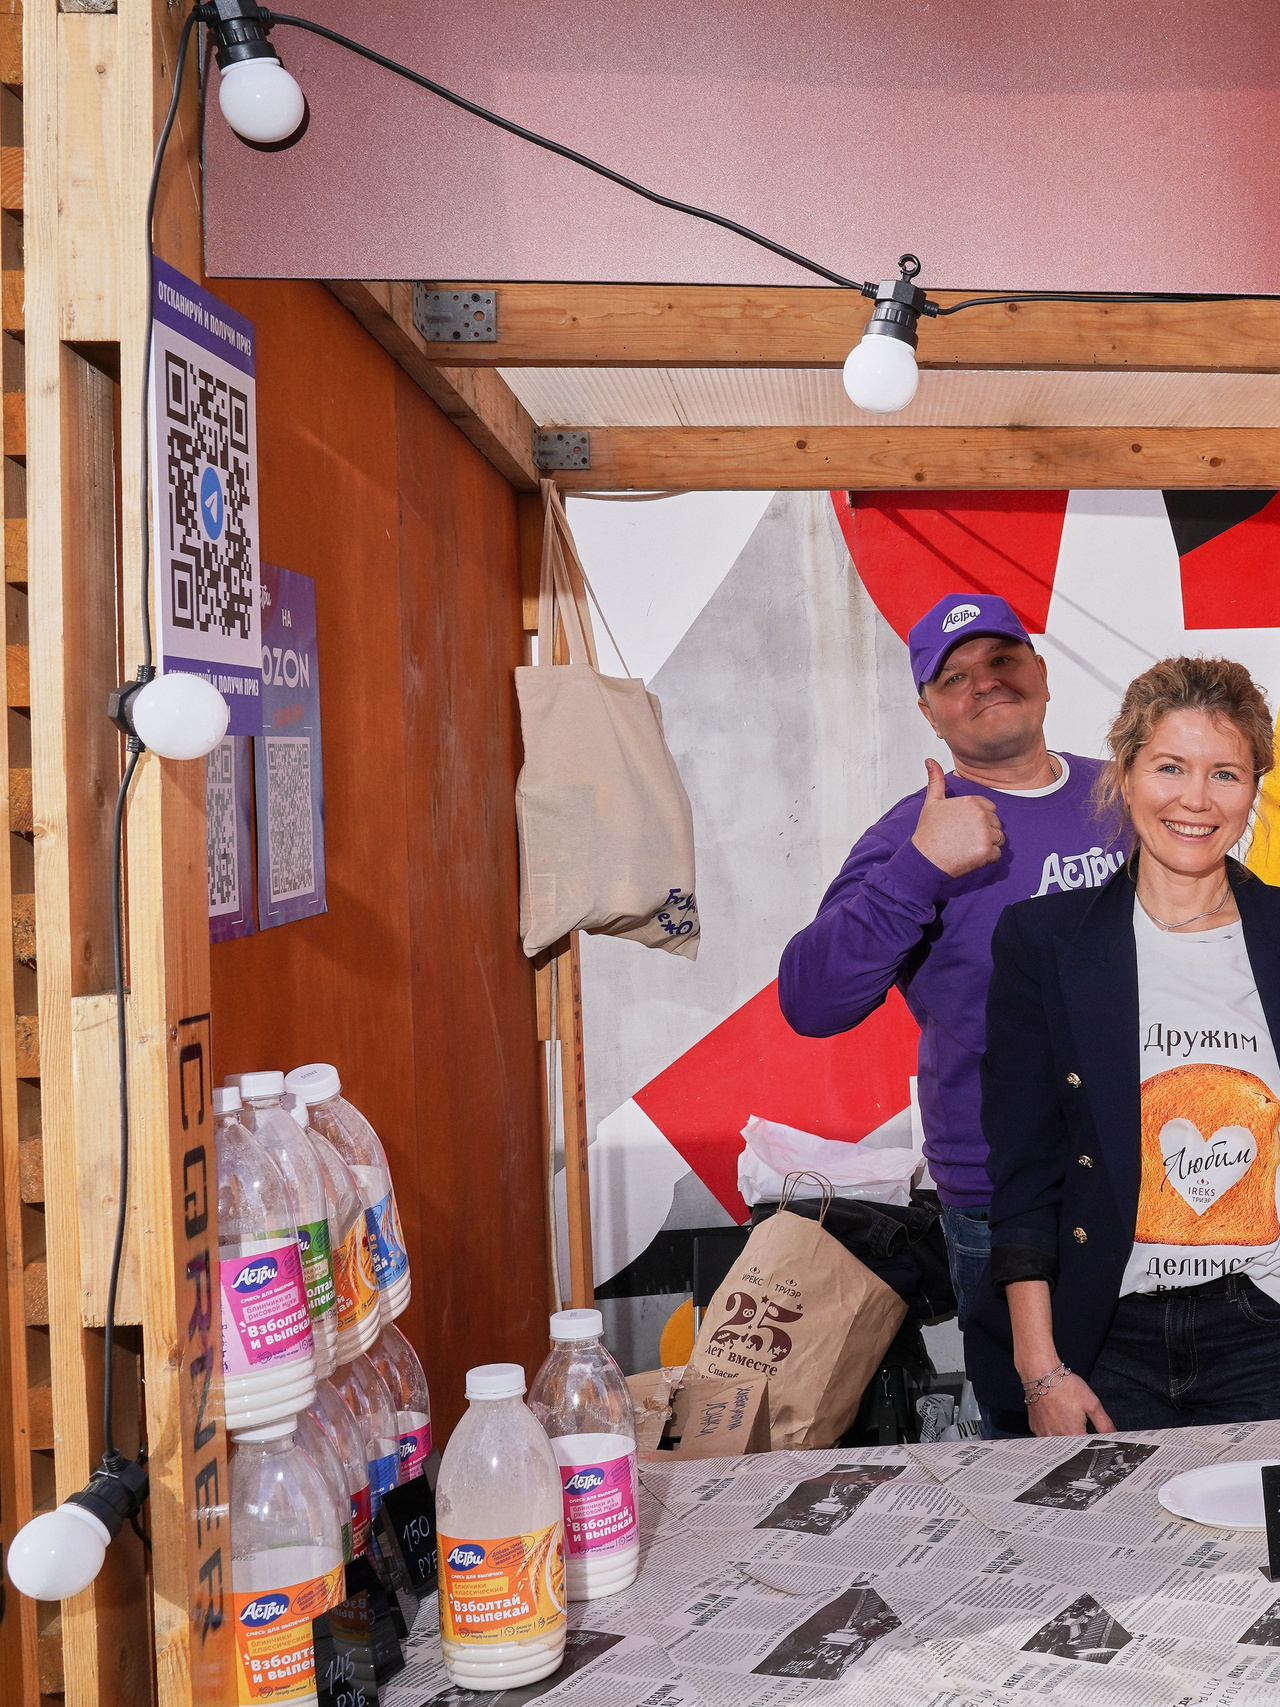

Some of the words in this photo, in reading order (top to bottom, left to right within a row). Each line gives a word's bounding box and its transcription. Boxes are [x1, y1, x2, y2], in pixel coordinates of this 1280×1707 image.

[158, 280, 203, 325] ОТСКАНИРУЙ
[204, 311, 209, 330] И
[209, 314, 236, 346] ПОЛУЧИ
[236, 331, 252, 357] ПРИЗ
[281, 609, 292, 628] НА
[943, 610, 978, 631] Астри
[261, 644, 311, 689] OZON
[219, 675, 244, 695] ПОЛУЧИ
[244, 679, 259, 697] ПРИЗ
[1030, 847, 1125, 898] Астри
[1144, 1023, 1258, 1058] Дружим
[1160, 1140, 1252, 1193] Любим
[1188, 1186, 1216, 1197] IREKS
[231, 1265, 278, 1289] Астри
[742, 1273, 764, 1286] ИРЕКС
[240, 1295, 260, 1304] смесь
[261, 1289, 273, 1299] для
[274, 1281, 294, 1293] выпечки
[774, 1284, 802, 1298] ТРИЭР
[246, 1297, 284, 1313] блинчики
[285, 1293, 292, 1301] из
[248, 1304, 280, 1320] рисовой
[282, 1298, 297, 1309] муки
[247, 1303, 307, 1338] Взболтай
[709, 1291, 804, 1363] 25
[180, 1043, 223, 1647] CORNER
[250, 1339, 261, 1350] и
[727, 1353, 778, 1376] вместе
[564, 1474, 604, 1490] Астри
[586, 1494, 597, 1502] для
[598, 1487, 619, 1499] выпечки
[572, 1500, 606, 1512] блинчики
[573, 1507, 603, 1519] рисовой
[603, 1501, 620, 1511] муки
[572, 1506, 629, 1533] Взболтай
[573, 1533, 582, 1542] и
[585, 1513, 634, 1540] выпекай
[403, 1515, 430, 1552] 150
[447, 1547, 484, 1567] Астри
[477, 1570, 504, 1579] выпечки
[455, 1586, 504, 1596] классические
[239, 1602, 288, 1620] Астри
[454, 1593, 521, 1612] Взболтай
[455, 1613, 462, 1623] и
[465, 1602, 530, 1623] выпекай
[246, 1629, 266, 1638] смесь
[267, 1626, 280, 1634] для
[281, 1615, 310, 1630] выпечки
[251, 1632, 292, 1648] блинчики
[252, 1632, 311, 1655] классические
[251, 1644, 315, 1672] Взболта
[252, 1673, 263, 1684] и
[325, 1648, 356, 1695] 145
